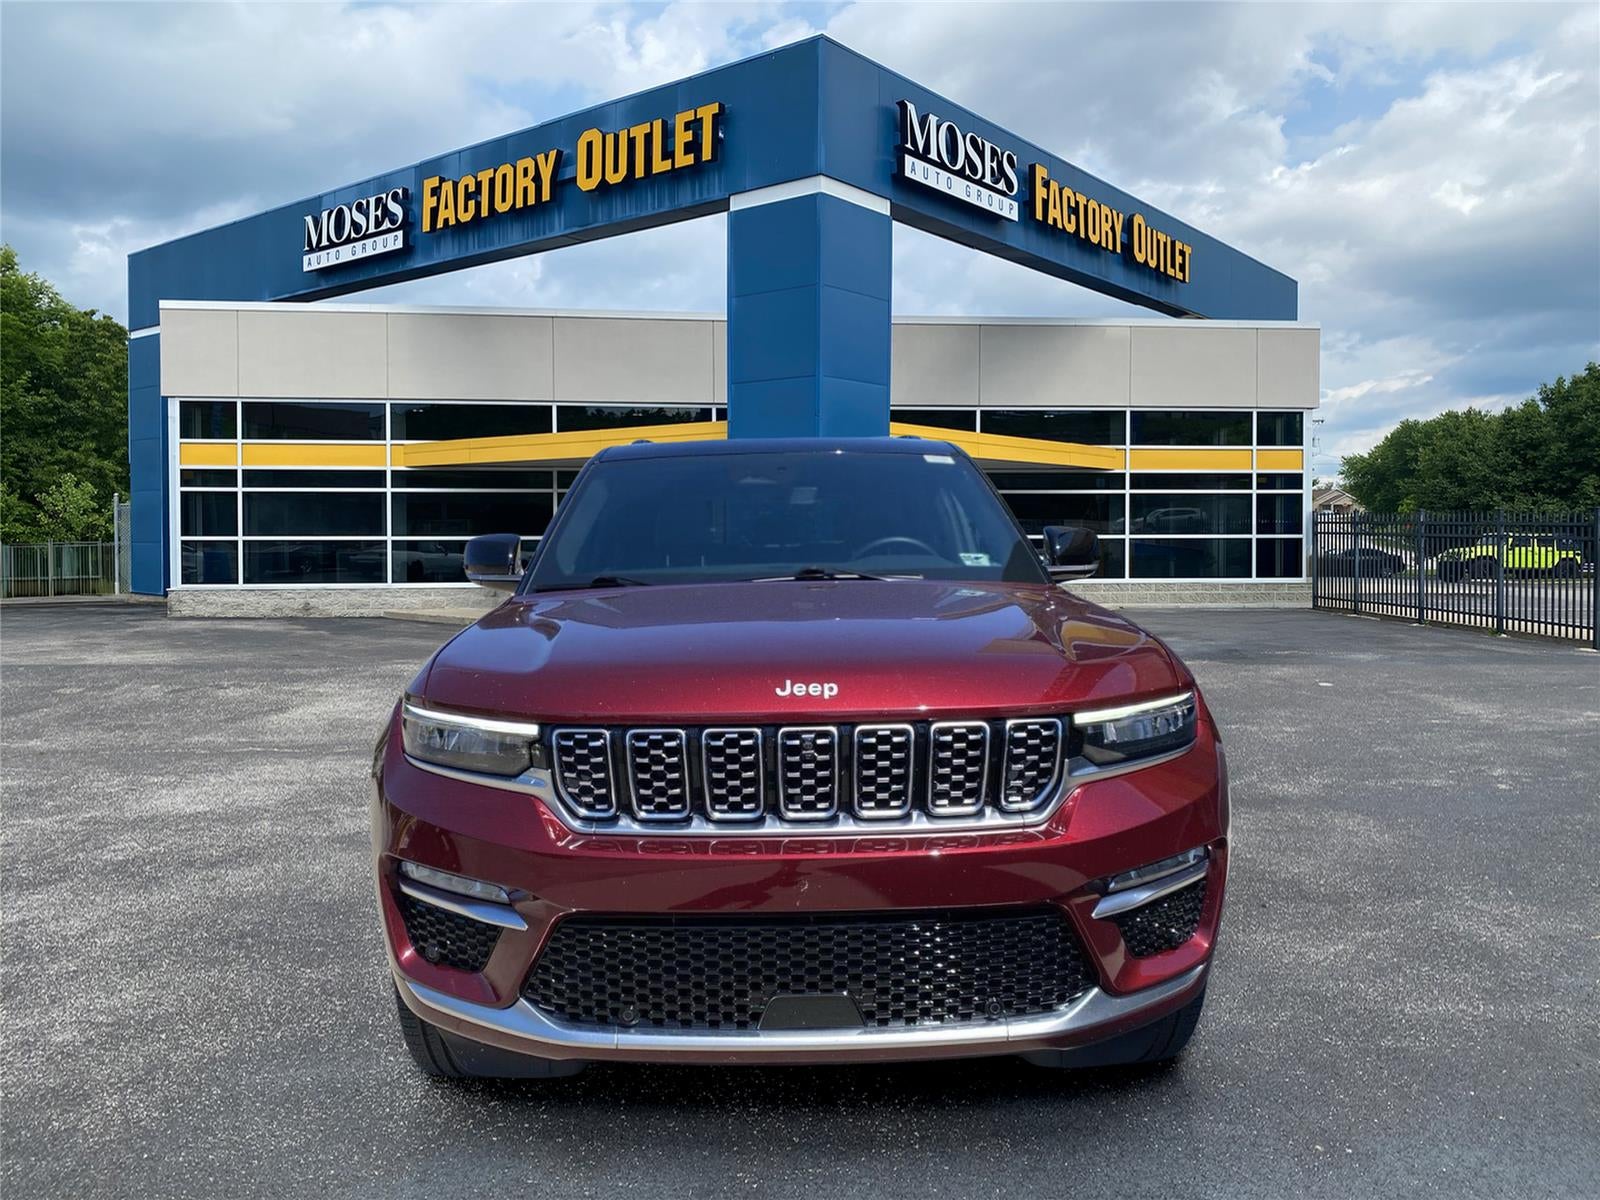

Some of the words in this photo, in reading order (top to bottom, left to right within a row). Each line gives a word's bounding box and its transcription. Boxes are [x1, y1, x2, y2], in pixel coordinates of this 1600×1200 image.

[421, 148, 558, 232] FACTORY
[576, 102, 720, 192] OUTLET
[904, 100, 1018, 196] MOSES
[303, 187, 404, 251] MOSES
[910, 161, 952, 190] AUTO
[965, 184, 1014, 214] GROUP
[307, 250, 341, 268] AUTO
[351, 235, 399, 256] GROUP
[1034, 162, 1125, 253] FACTORY
[1133, 213, 1192, 283] OUTLET
[775, 679, 838, 699] Jeep
